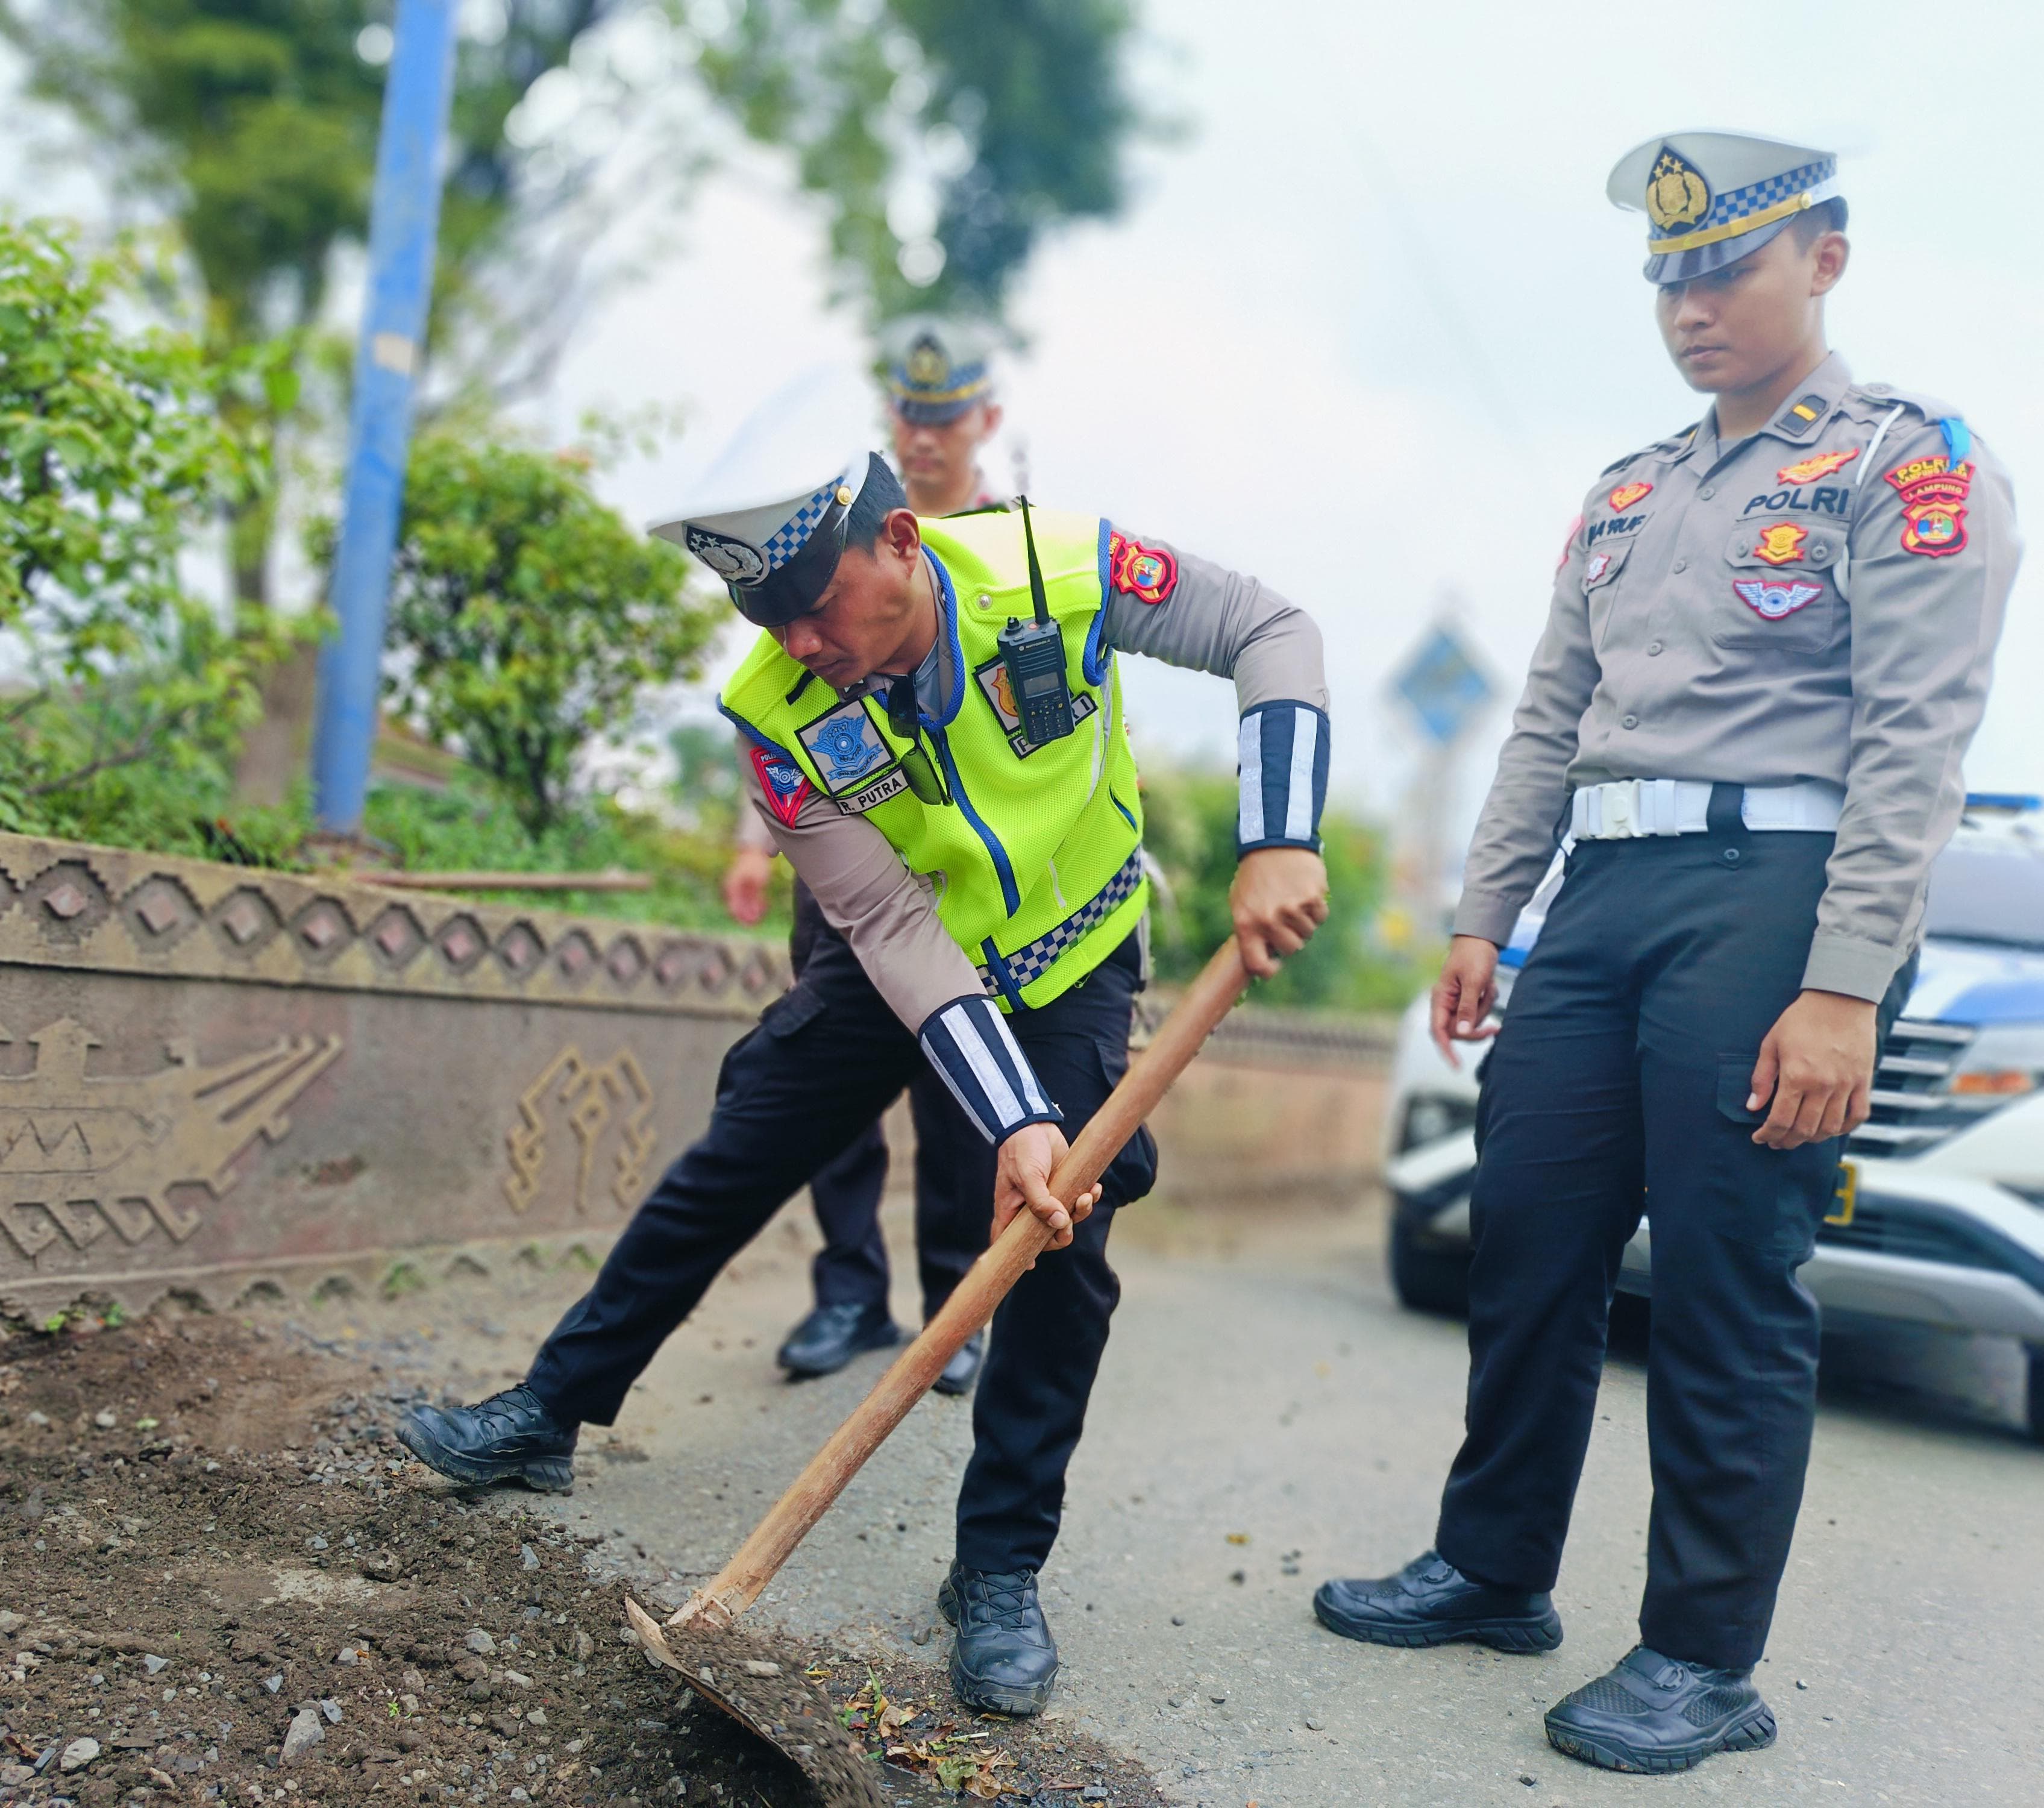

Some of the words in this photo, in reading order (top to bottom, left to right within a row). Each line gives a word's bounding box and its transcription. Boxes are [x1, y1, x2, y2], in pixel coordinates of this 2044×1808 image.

[1743, 486, 1849, 515] POLRI
[1908, 483, 1963, 498] LAMPUNG
[839, 802, 855, 811] R.
[857, 777, 902, 808] PUTRA
